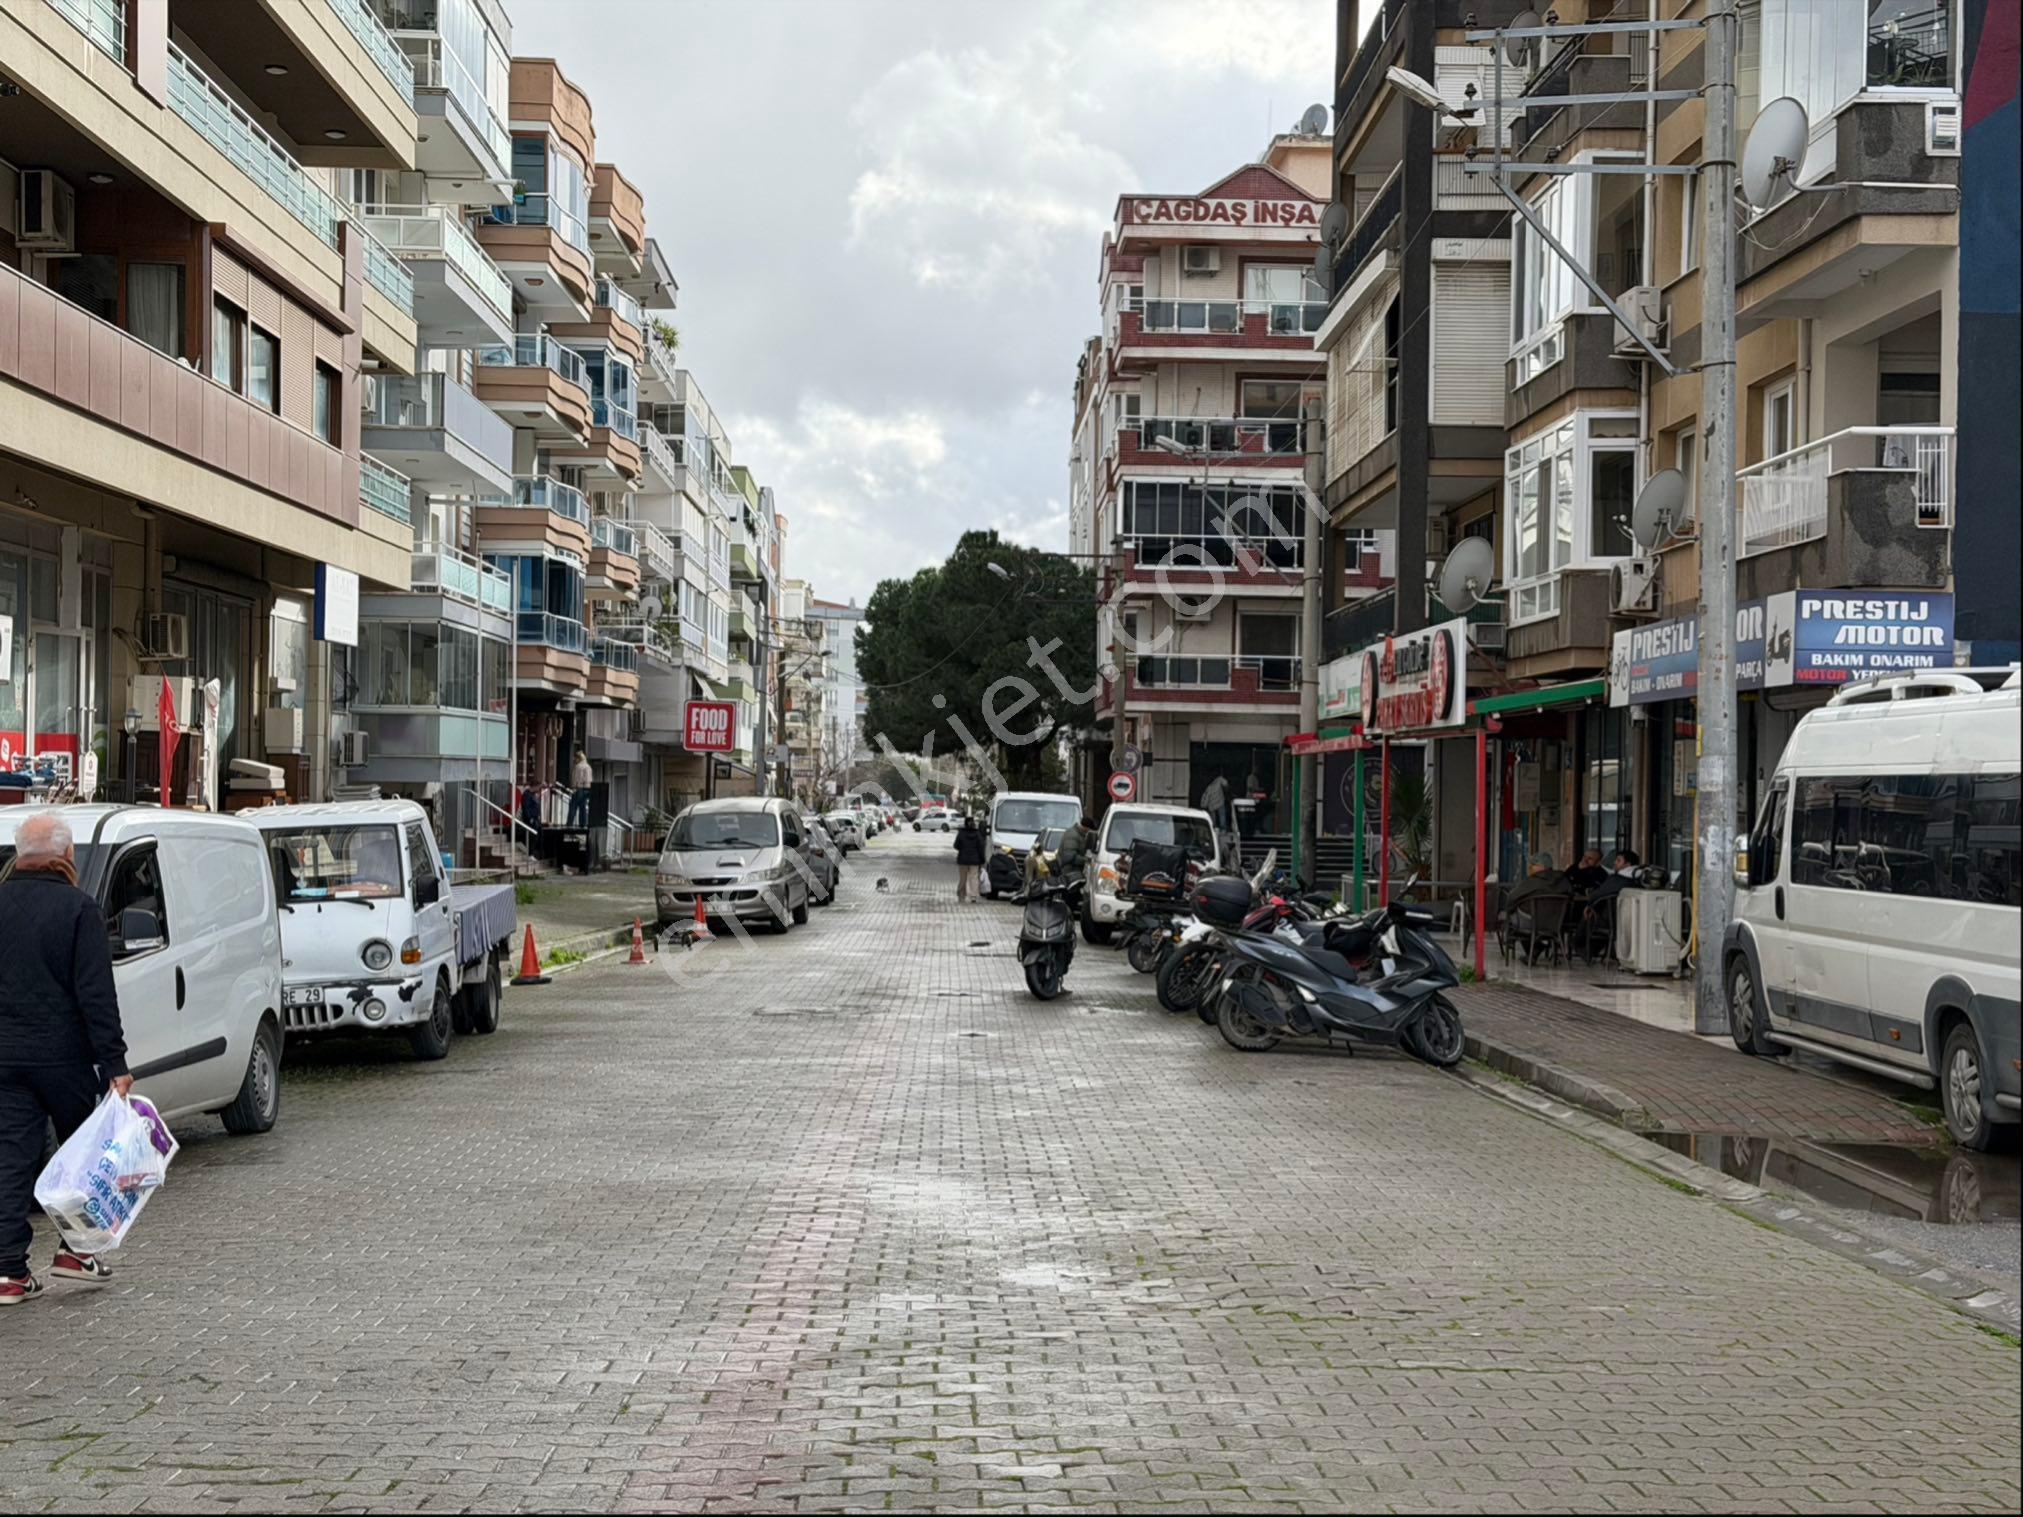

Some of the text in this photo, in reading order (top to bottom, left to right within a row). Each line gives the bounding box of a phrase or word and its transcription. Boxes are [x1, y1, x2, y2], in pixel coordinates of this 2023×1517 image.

[1800, 599, 1929, 621] PRESTIJ
[1833, 624, 1945, 646] MOTOR
[1811, 653, 1934, 667] BAKIM ONARIM
[1796, 669, 1847, 681] MOTOR
[691, 707, 728, 731] FOOD
[691, 731, 727, 746] FOR LOVE
[305, 988, 320, 1002] 29
